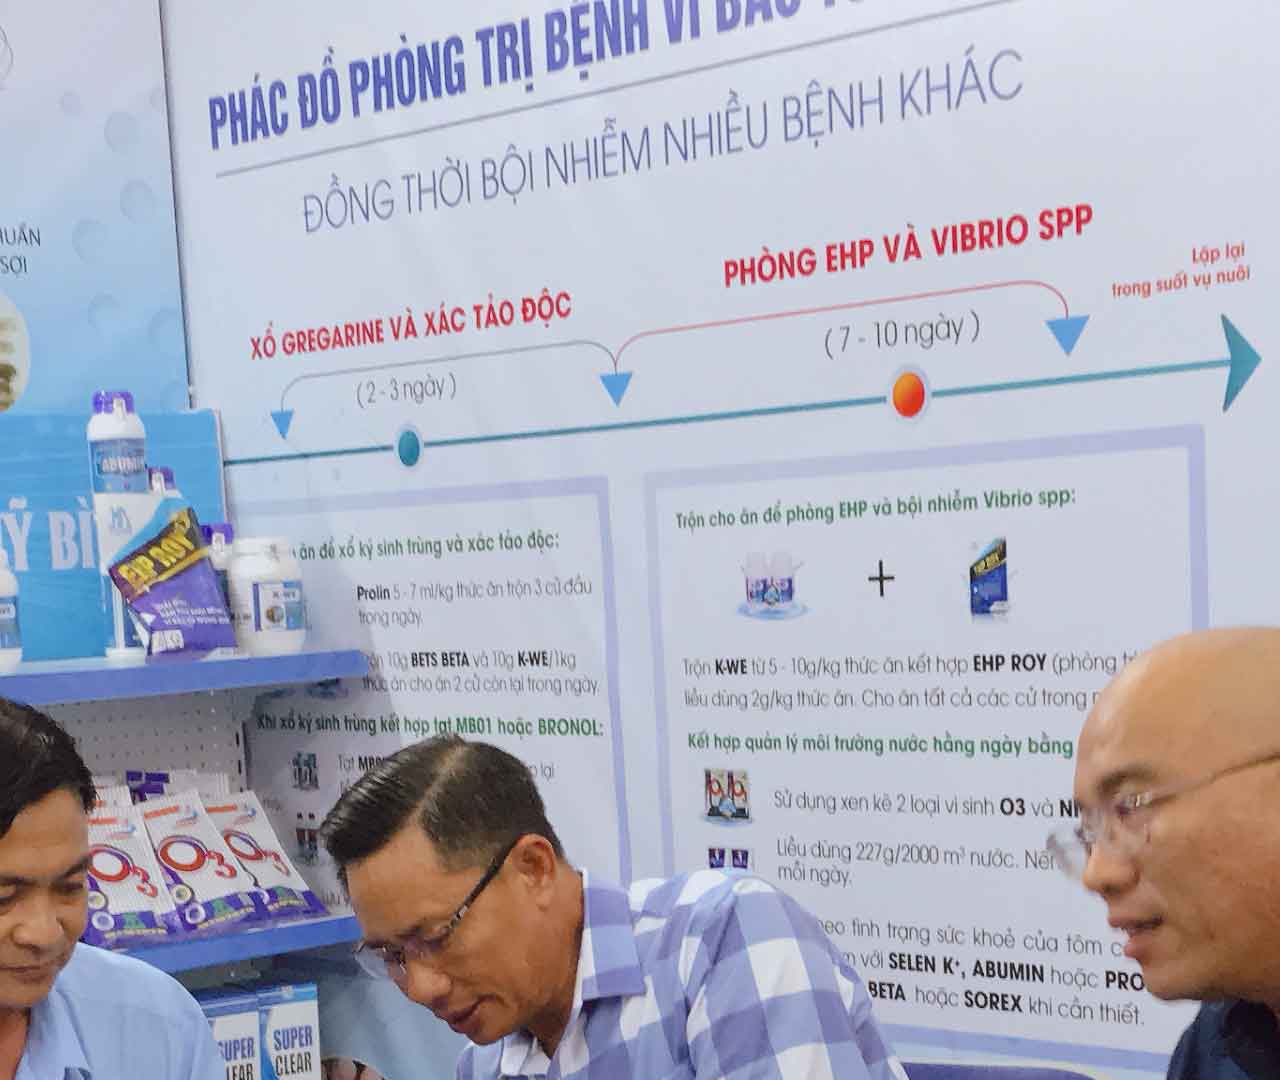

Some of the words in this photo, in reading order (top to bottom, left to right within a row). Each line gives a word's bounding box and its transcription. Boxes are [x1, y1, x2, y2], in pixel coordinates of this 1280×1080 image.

[208, 71, 288, 150] PHÁC
[298, 45, 340, 130] ĐỒ
[350, 35, 466, 117] PHÒNG
[476, 18, 535, 92] TRỊ
[544, 0, 650, 81] BỆNH
[663, 0, 702, 43] VI
[304, 173, 395, 233] ĐỒNG
[402, 157, 471, 214] THỜI
[481, 144, 534, 205] BỘI
[544, 117, 652, 185] NHIỄM
[663, 88, 769, 167] NHIỀU
[783, 79, 885, 151] BỆNH
[900, 44, 1024, 121] KHÁC
[724, 247, 817, 288] PHÒNG
[825, 238, 875, 273] EHP
[883, 223, 922, 263] VÀ
[931, 215, 1028, 257] VIBRIO
[1039, 203, 1094, 241] SPP
[1225, 243, 1245, 261] lại
[1111, 276, 1152, 299] trong
[1155, 272, 1188, 293] suốt
[1192, 272, 1212, 291] vụ
[1215, 265, 1251, 285] nuôi
[250, 323, 277, 360] XỔ
[282, 318, 385, 356] GREGARINE
[389, 309, 418, 341] VÀ
[425, 302, 467, 338] XÁC
[473, 293, 515, 330] TẢO
[522, 287, 572, 330] ĐỘC
[676, 512, 705, 533] Trộn
[709, 508, 736, 527] cho
[740, 505, 759, 525] ăn
[763, 499, 782, 524] để
[786, 504, 834, 525] phòng
[839, 500, 867, 518] EHP
[873, 498, 892, 516] và
[897, 494, 922, 515] bội
[927, 489, 978, 512] nhiễm
[983, 488, 1033, 509] Vibrio
[1038, 489, 1076, 507] spp:
[319, 532, 336, 560] để
[377, 538, 403, 557] sinh
[408, 538, 442, 559] trùng
[447, 531, 463, 553] và
[468, 534, 495, 552] xác
[499, 529, 522, 550] tảo
[528, 531, 559, 554] độc:
[357, 584, 391, 602] Prolin
[411, 651, 439, 668] BETS
[442, 650, 469, 667] BETA
[715, 659, 748, 676] K-WE
[973, 655, 1006, 672] EHP
[1010, 653, 1046, 672] ROY
[345, 716, 377, 736] trùng
[381, 711, 400, 733] kết
[456, 717, 492, 735] MB01
[497, 716, 532, 739] hoặc
[538, 717, 603, 737] BRONOL:
[688, 731, 710, 752] Kết
[713, 734, 741, 754] hợp
[745, 735, 782, 754] quản
[803, 734, 831, 752] môi
[835, 734, 884, 757] trường
[889, 734, 929, 754] nước
[933, 728, 974, 757] hằng
[980, 736, 1022, 758] ngày
[1028, 731, 1073, 759] bằng
[795, 791, 837, 814] dụng
[841, 794, 869, 812] xen
[897, 795, 906, 812] 2
[910, 794, 941, 815] loại
[962, 796, 995, 816] sinh
[999, 798, 1026, 816] O3
[1032, 799, 1054, 817] và
[862, 951, 884, 969] với
[888, 952, 936, 972] SELEN
[972, 961, 1045, 983] ABUMIN
[1050, 965, 1099, 989] hoặc
[915, 988, 960, 1008] hoặc
[964, 991, 1022, 1012] SOREX
[1029, 995, 1053, 1016] khi
[1058, 996, 1094, 1021] cần
[1100, 997, 1144, 1025] thiết.
[273, 1024, 313, 1051] SUPER
[275, 1050, 313, 1077] CLEAR
